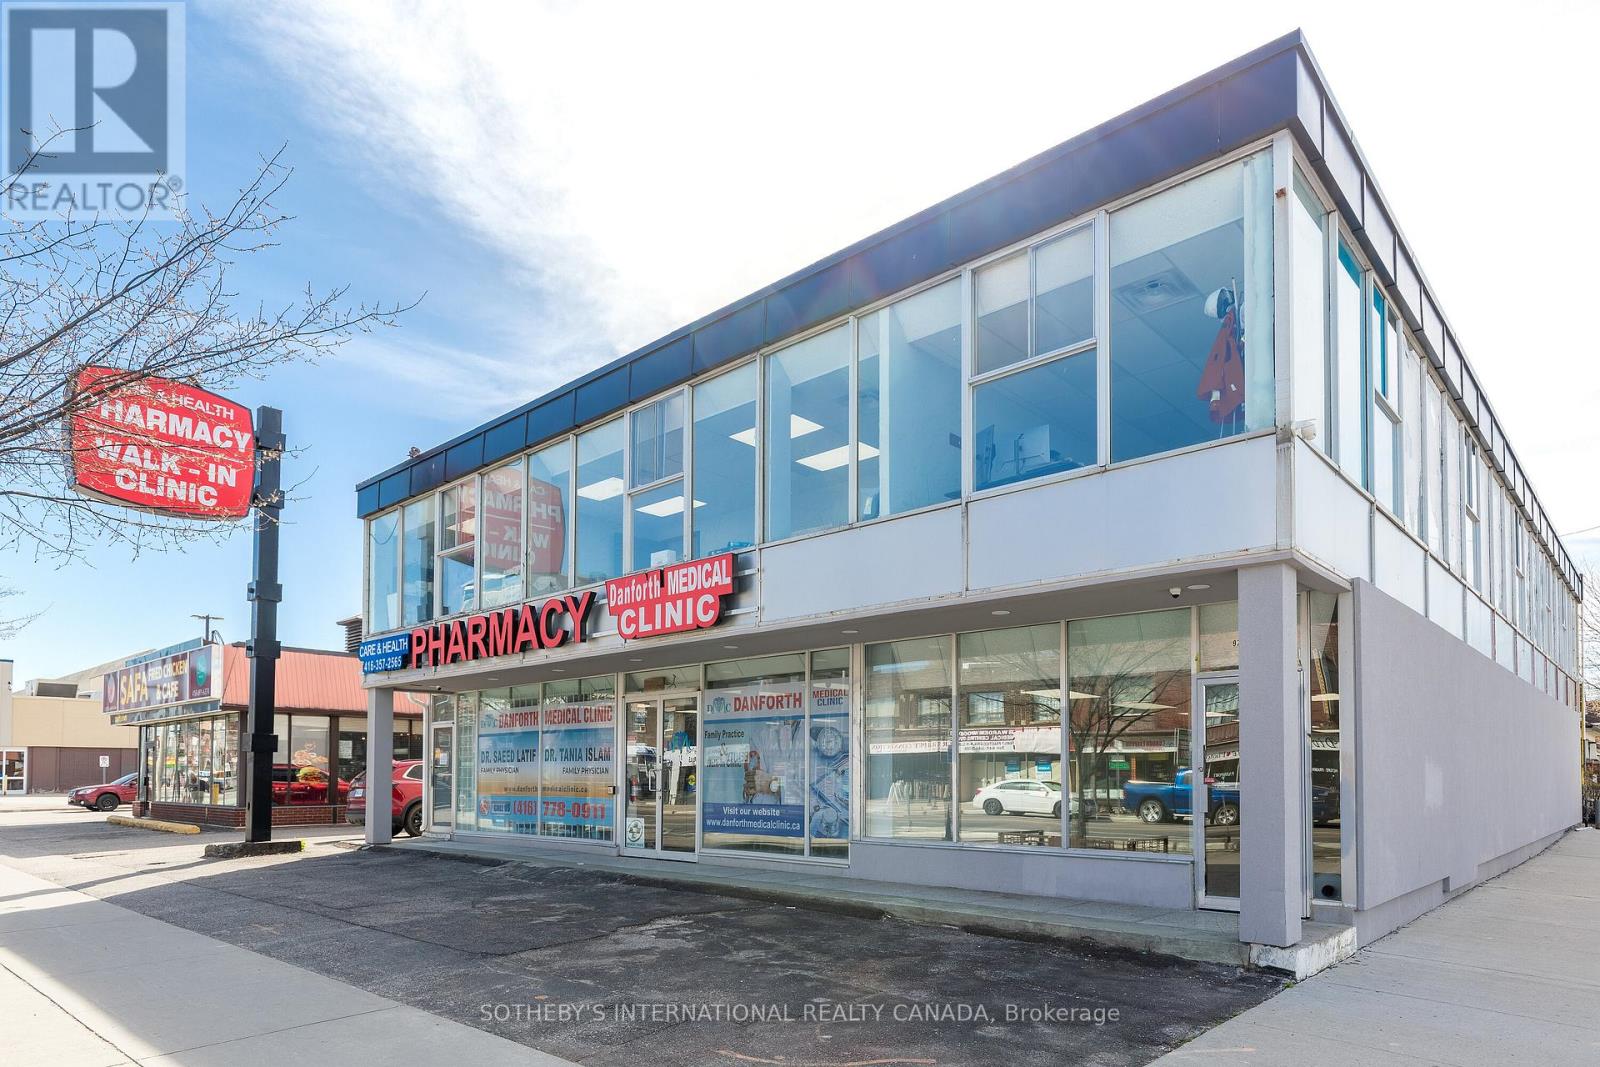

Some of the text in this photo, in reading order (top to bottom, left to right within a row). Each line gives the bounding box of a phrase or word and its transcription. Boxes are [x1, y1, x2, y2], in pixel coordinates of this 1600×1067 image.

[173, 394, 234, 420] HEALTH
[95, 437, 181, 476] WALK
[208, 463, 236, 487] IN
[114, 468, 218, 507] CLINIC
[609, 559, 732, 607] Danforth MEDICAL
[620, 594, 715, 635] CLINIC
[411, 592, 594, 669] PHARMACY
[359, 637, 408, 658] CARE & HEALTH
[120, 670, 148, 705] SAFA
[162, 681, 179, 699] CAFE
[812, 688, 848, 699] MEDICAL
[733, 692, 803, 712] DANFORTH
[816, 697, 844, 707] CLINIC
[499, 705, 613, 728] DANFORTH MEDICAL CLINIC
[704, 729, 744, 741] Family Practice
[480, 748, 537, 763] DR. SAEED LATIF
[544, 747, 611, 762] DR. TANIA ISLAM
[513, 800, 606, 820] (416) 778-0911
[722, 806, 738, 815] Visit
[752, 807, 780, 816] website
[705, 817, 801, 831] www.danforthmedicalclinic.ca
